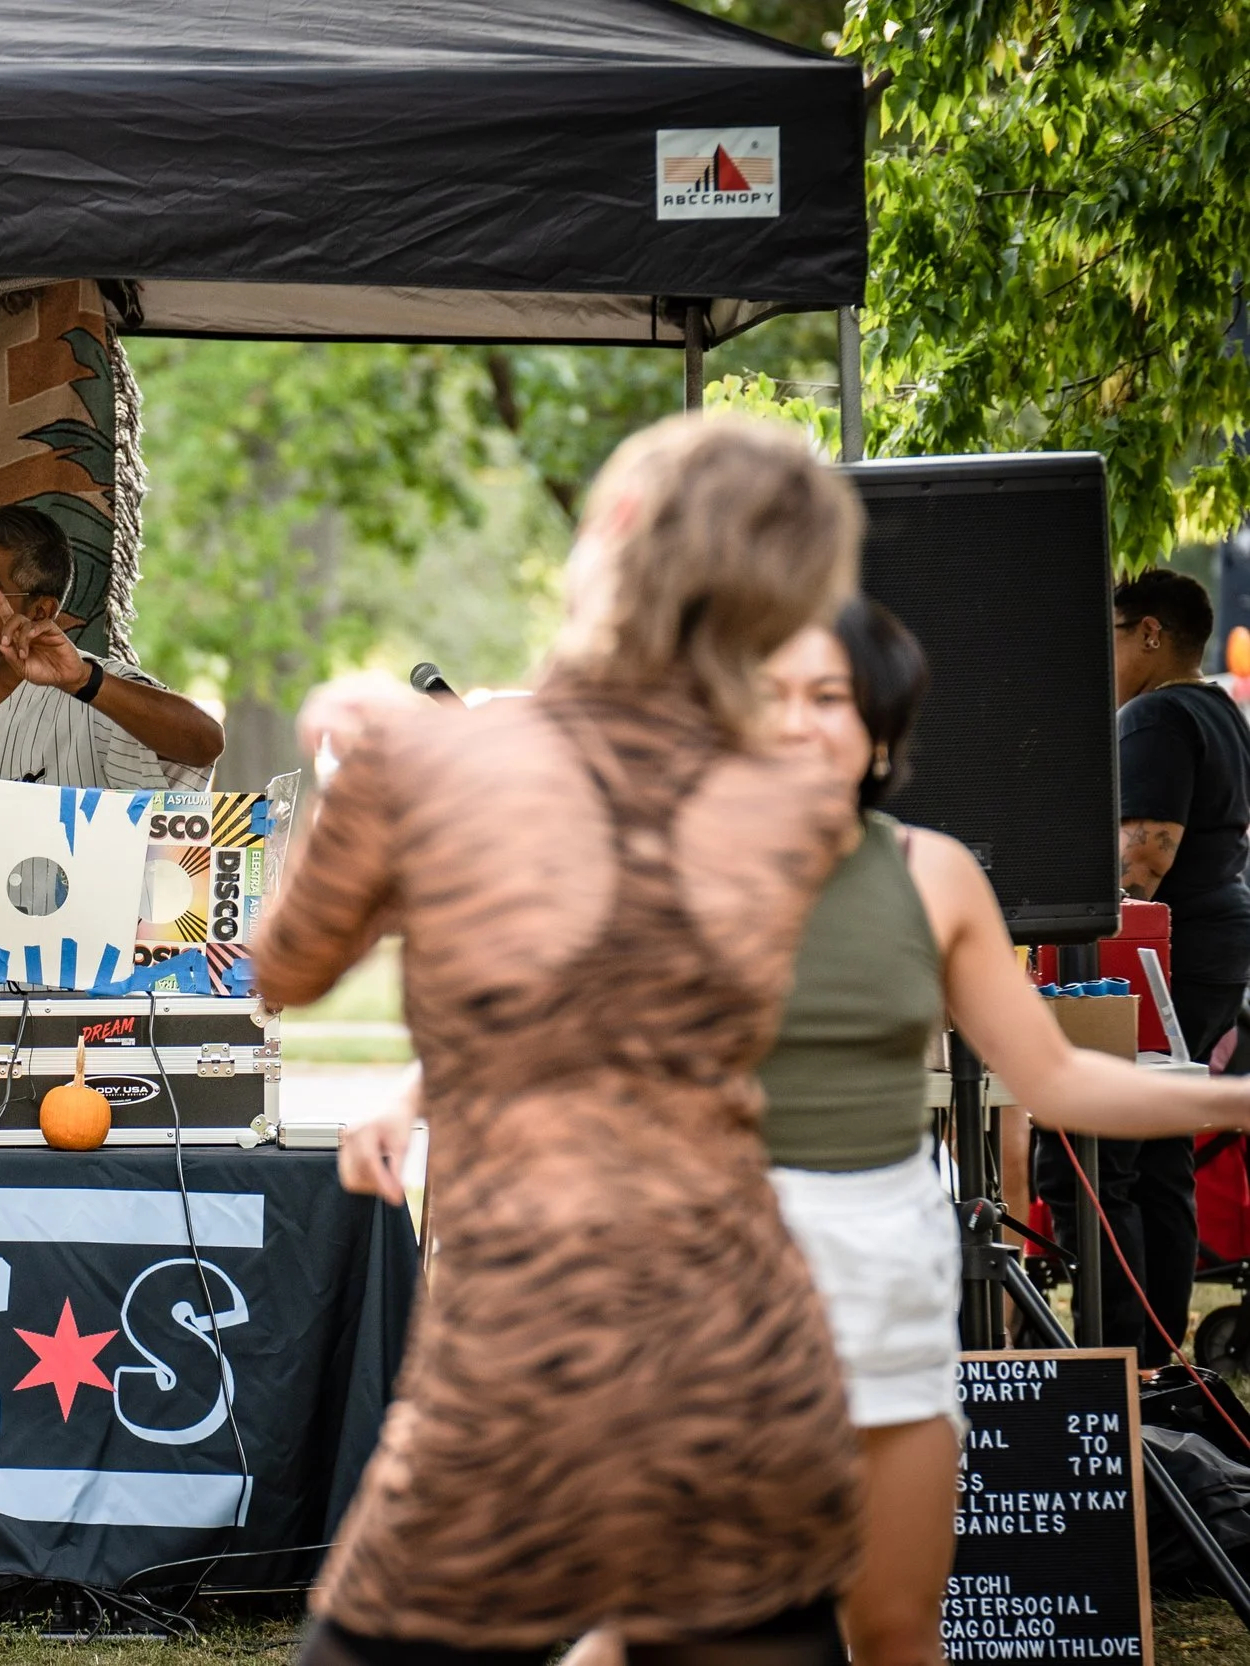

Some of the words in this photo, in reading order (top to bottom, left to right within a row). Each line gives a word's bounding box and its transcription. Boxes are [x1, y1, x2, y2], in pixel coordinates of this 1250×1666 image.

[663, 193, 774, 206] ABCCANOPY
[167, 795, 210, 805] ASYLUM
[150, 815, 209, 840] SCO
[250, 851, 261, 895] ELEKTRA
[213, 851, 241, 942] DISCO
[83, 1016, 135, 1042] DREAM
[123, 1086, 149, 1094] USA
[1080, 1436, 1108, 1454] TO
[953, 1514, 1066, 1535] BANGLES
[943, 1575, 1010, 1596] STCHI
